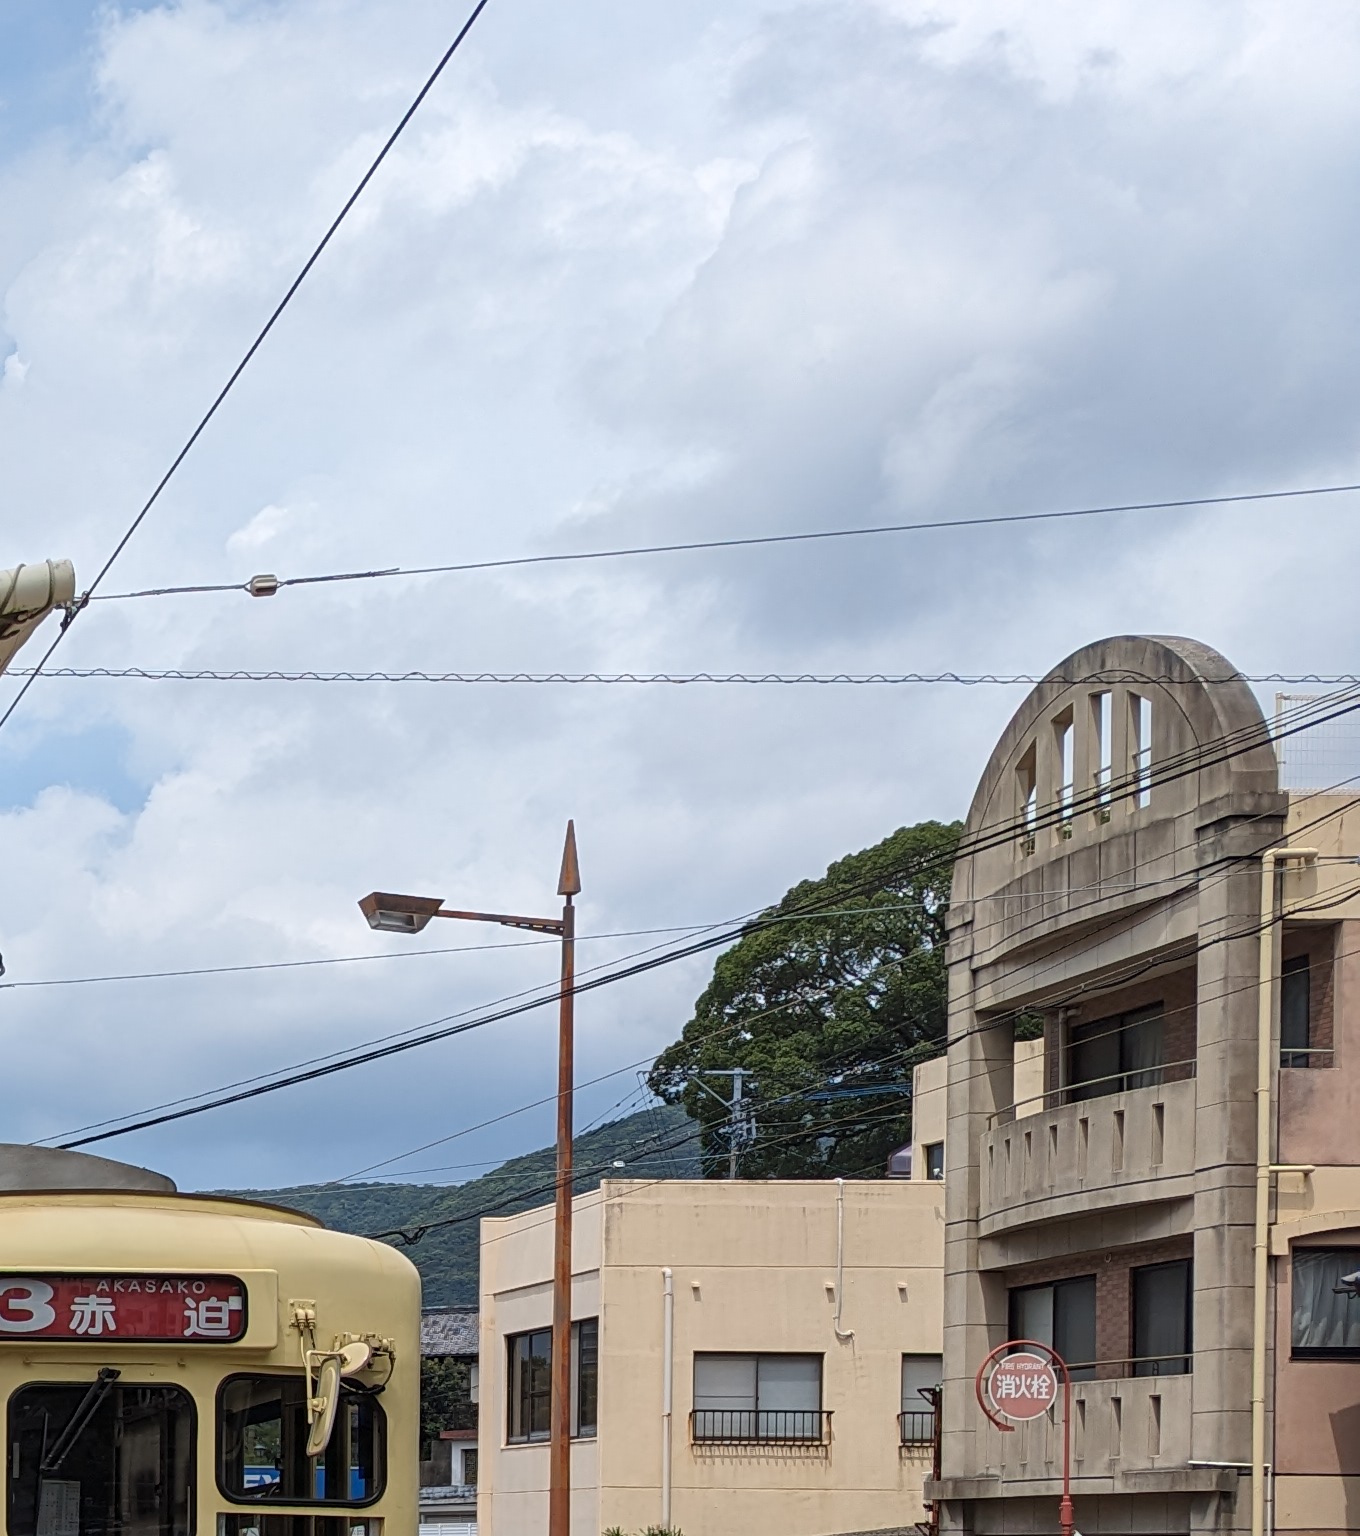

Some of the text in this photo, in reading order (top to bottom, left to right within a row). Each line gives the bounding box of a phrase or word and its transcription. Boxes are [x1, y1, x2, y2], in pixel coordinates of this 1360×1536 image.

[96, 1280, 206, 1294] AKASAKO
[1001, 1363, 1015, 1371] FIRE
[996, 1374, 1051, 1399] 消火栓
